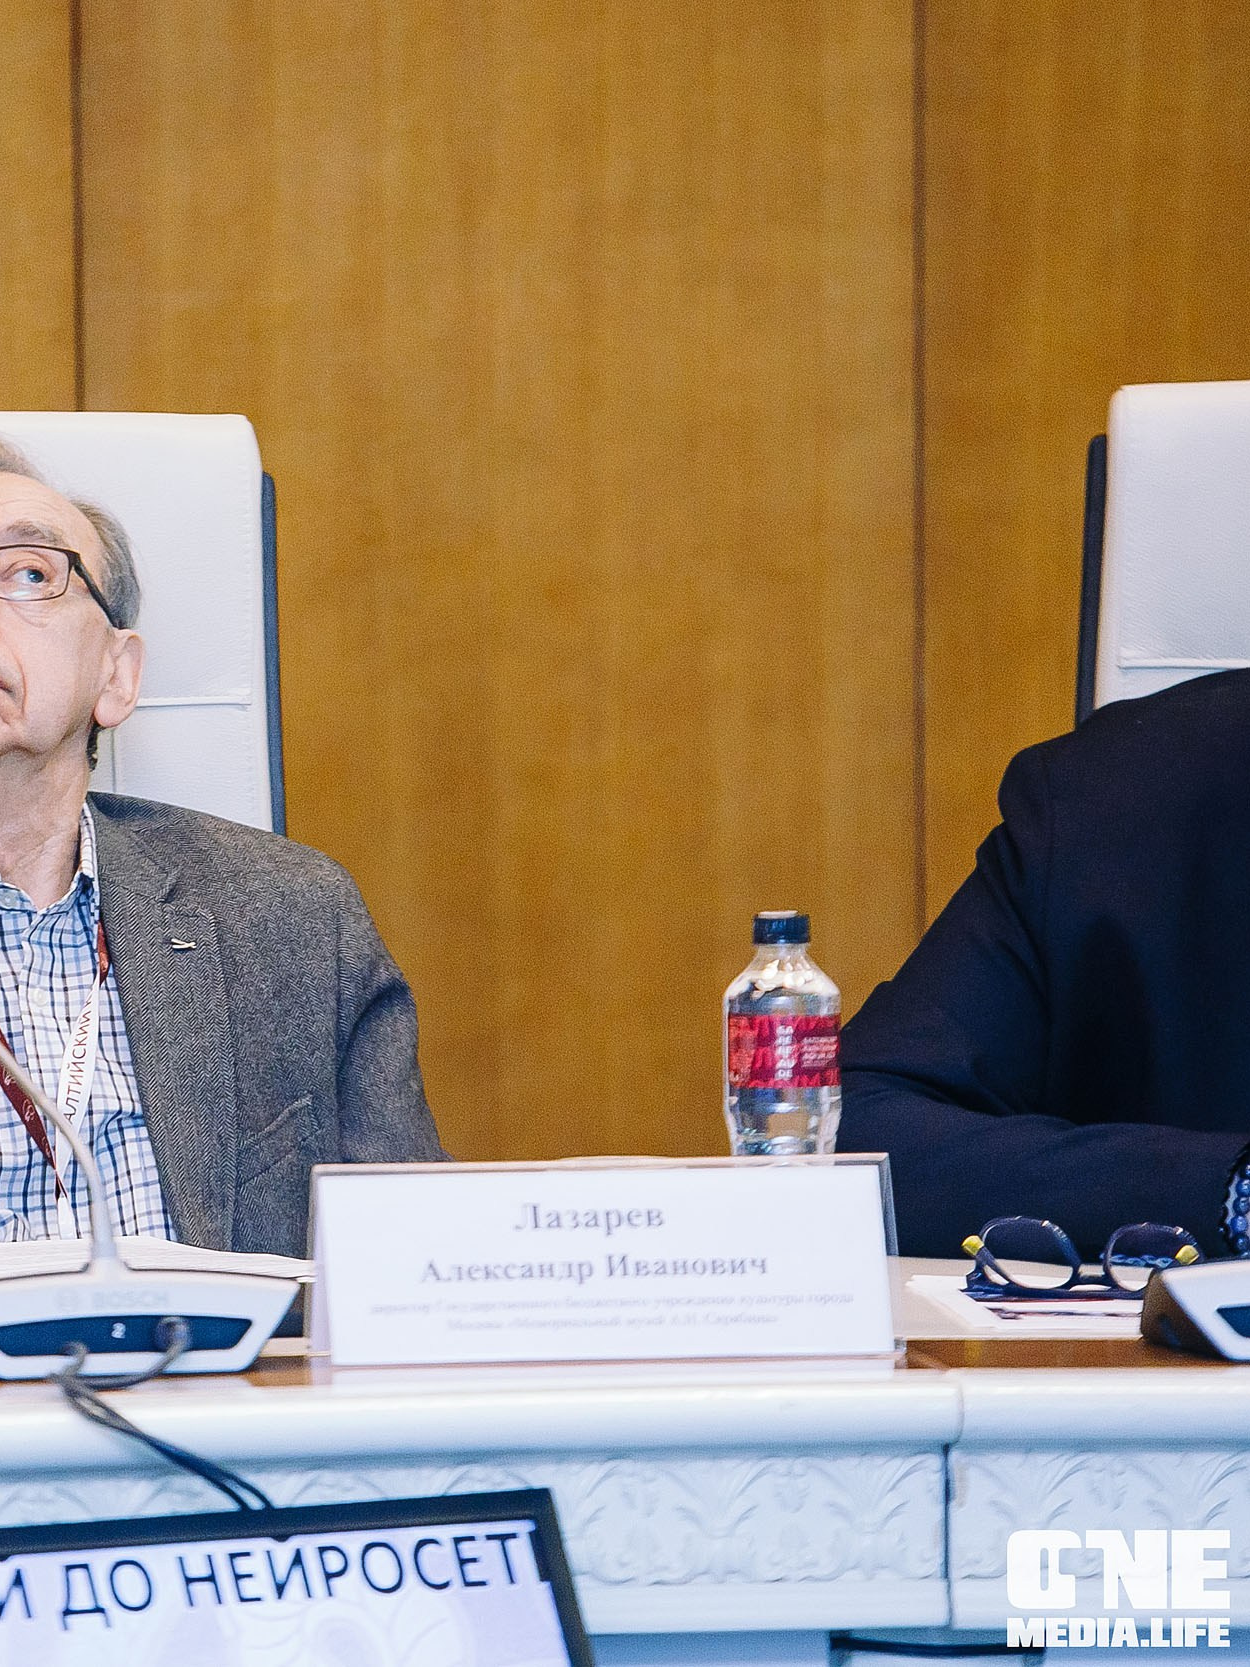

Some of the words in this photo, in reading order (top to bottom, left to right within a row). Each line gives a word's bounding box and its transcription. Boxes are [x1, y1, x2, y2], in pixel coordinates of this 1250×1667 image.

[514, 1202, 665, 1235] Лазарев
[420, 1258, 595, 1284] Александр
[605, 1253, 769, 1278] Иванович
[59, 1560, 152, 1632] ДО
[177, 1532, 520, 1609] НЕЙРОСЕТ
